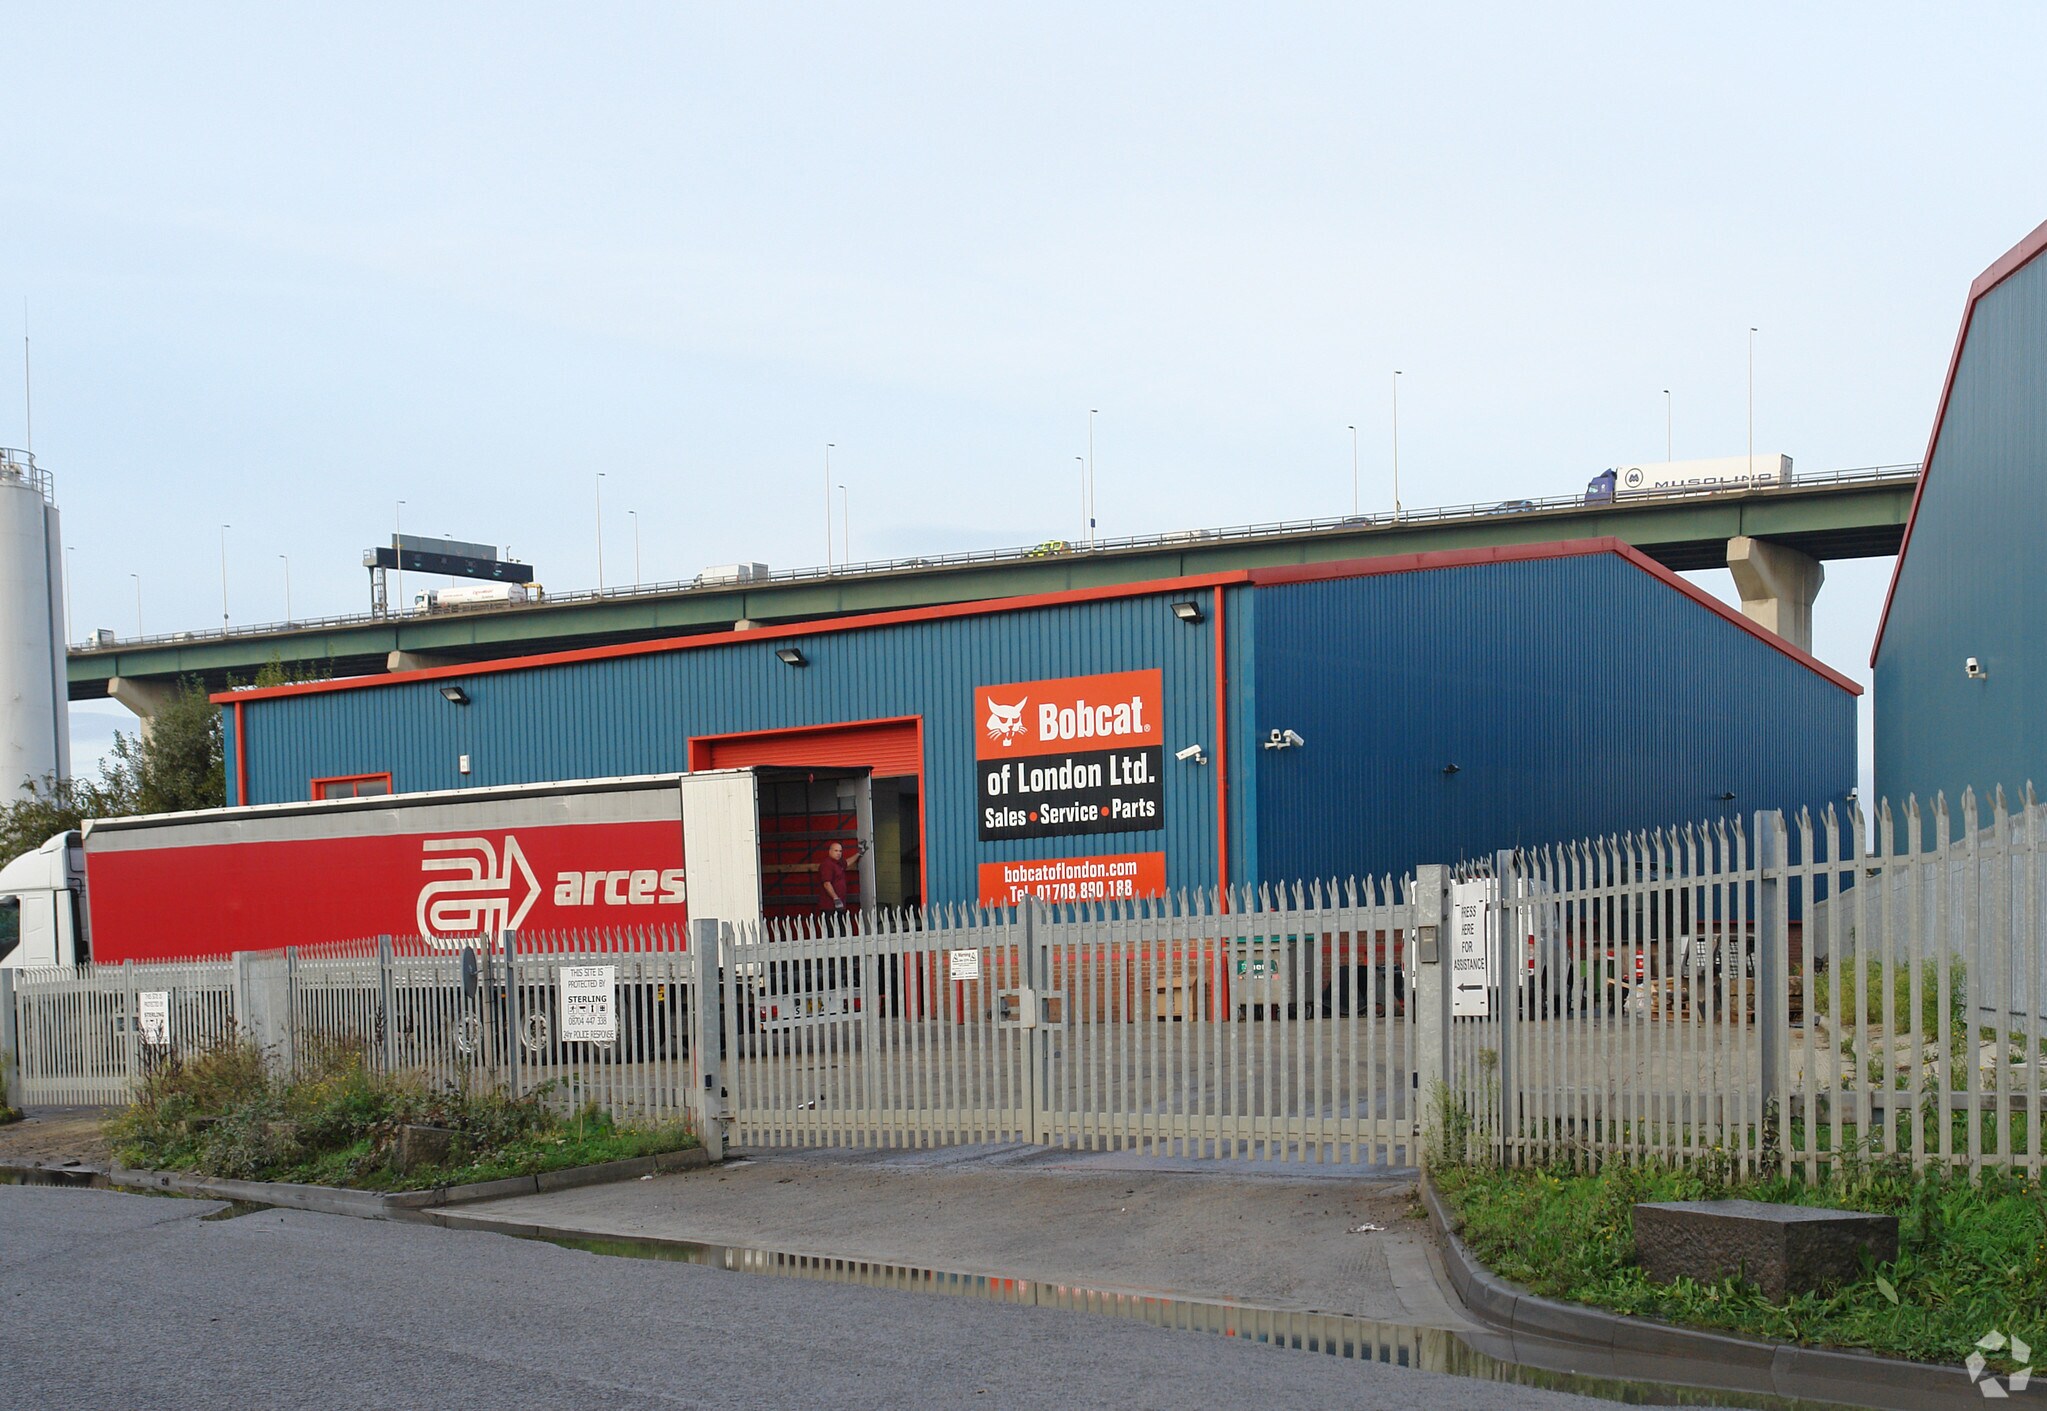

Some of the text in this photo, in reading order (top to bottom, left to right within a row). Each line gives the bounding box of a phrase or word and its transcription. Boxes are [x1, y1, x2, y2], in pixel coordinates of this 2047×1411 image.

[1655, 473, 1771, 488] MUSOLINO
[1038, 696, 1144, 742] Bobcat
[987, 752, 1155, 796] of London Ltd.
[985, 798, 1155, 829] Sales Service Parts
[1004, 861, 1137, 884] bobcatoflondon.com
[554, 868, 686, 906] arces
[1036, 882, 1076, 901] 01708
[1080, 880, 1104, 899] 890
[1108, 878, 1133, 897] 188
[1461, 905, 1476, 918] PRESS
[1461, 923, 1474, 936] HERE
[1461, 941, 1473, 953] FOR
[1454, 958, 1484, 971] ASSISTANCE
[570, 968, 604, 976] THIS SITE IS
[568, 979, 606, 988] PROTECTED BY
[568, 995, 607, 1003] STERLING
[573, 1030, 589, 1039] POLICE
